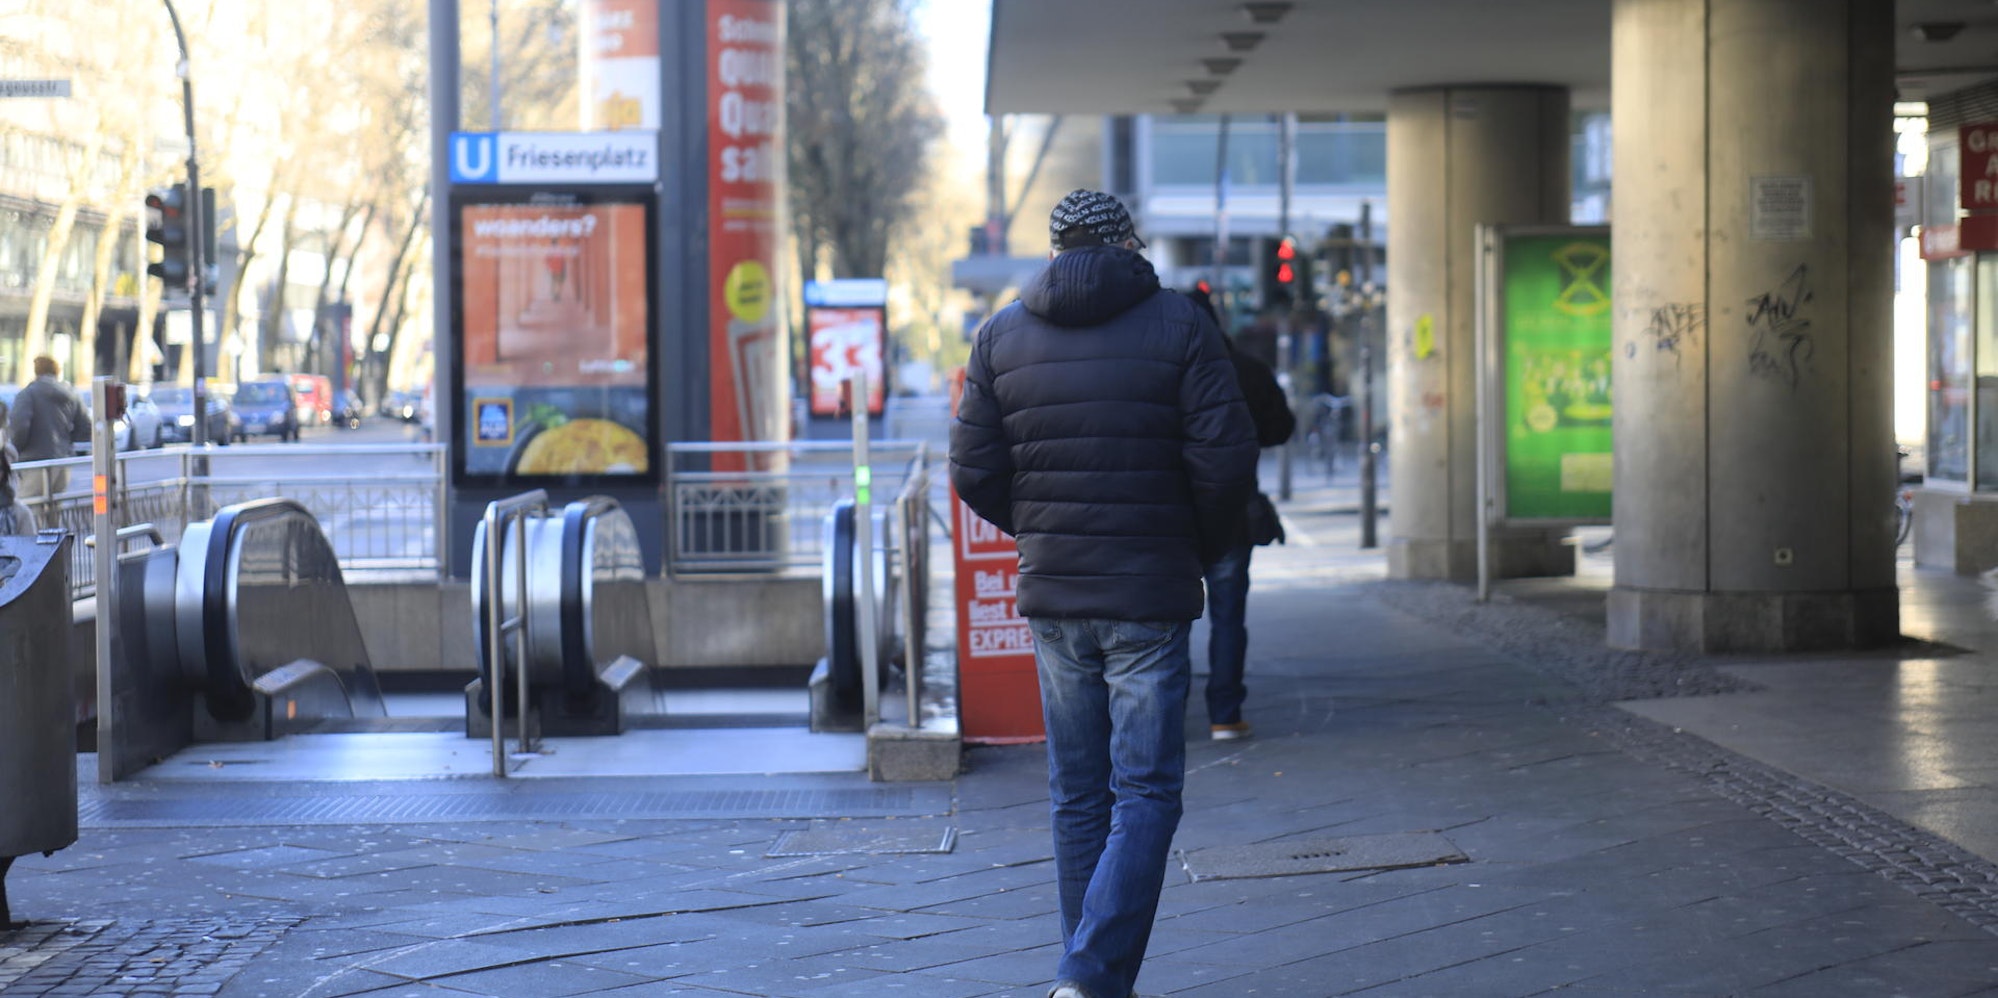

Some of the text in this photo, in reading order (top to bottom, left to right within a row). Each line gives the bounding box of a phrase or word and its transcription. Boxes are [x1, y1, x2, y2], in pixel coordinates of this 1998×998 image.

[456, 137, 648, 180] U Friesenplatz
[474, 214, 597, 239] woanders?
[974, 570, 1004, 591] Bei
